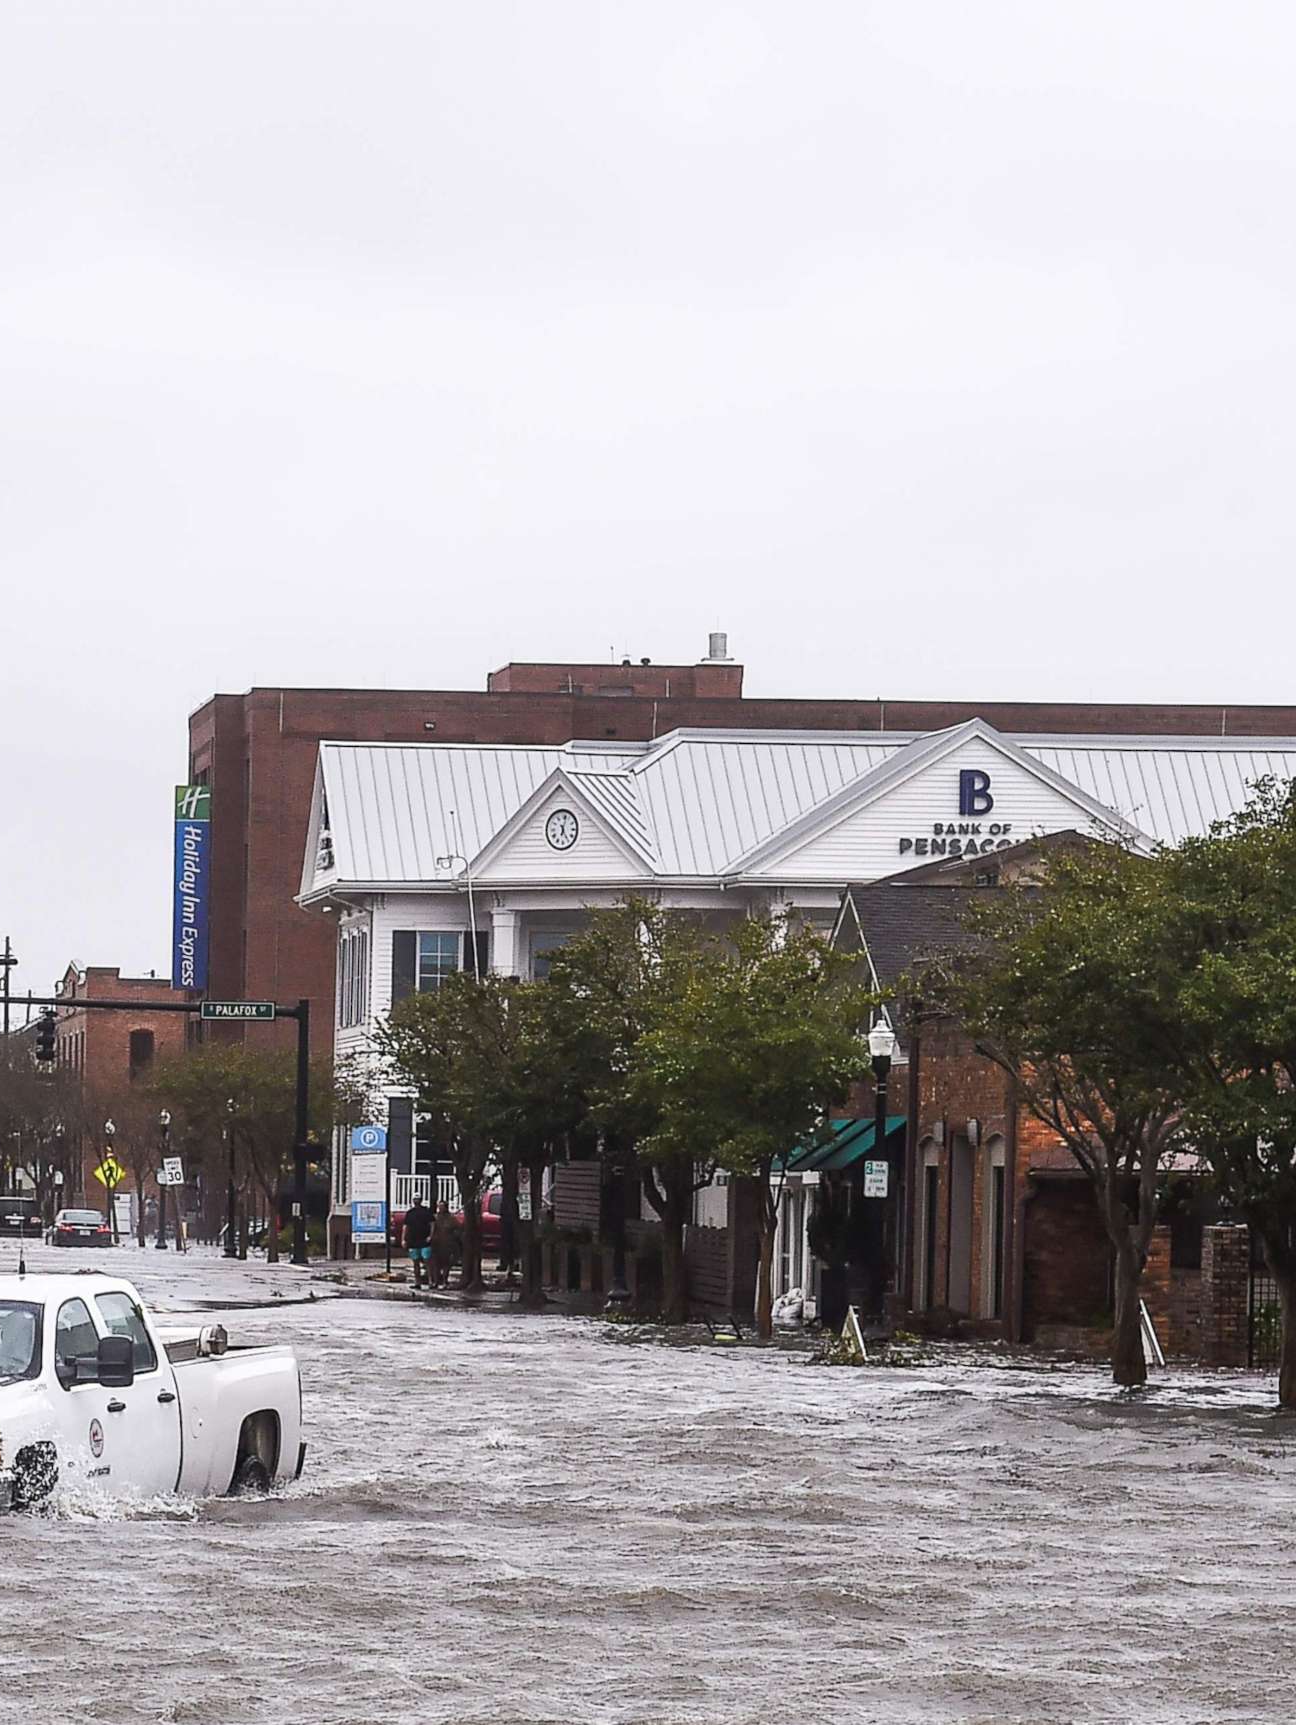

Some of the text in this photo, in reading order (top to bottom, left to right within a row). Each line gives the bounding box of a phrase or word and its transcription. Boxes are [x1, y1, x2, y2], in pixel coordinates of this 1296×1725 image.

[958, 769, 994, 816] B
[933, 823, 1012, 835] BANK OF
[179, 824, 202, 987] Holiday Inn Express
[215, 1005, 257, 1016] PALAFOX
[168, 1171, 182, 1182] 30
